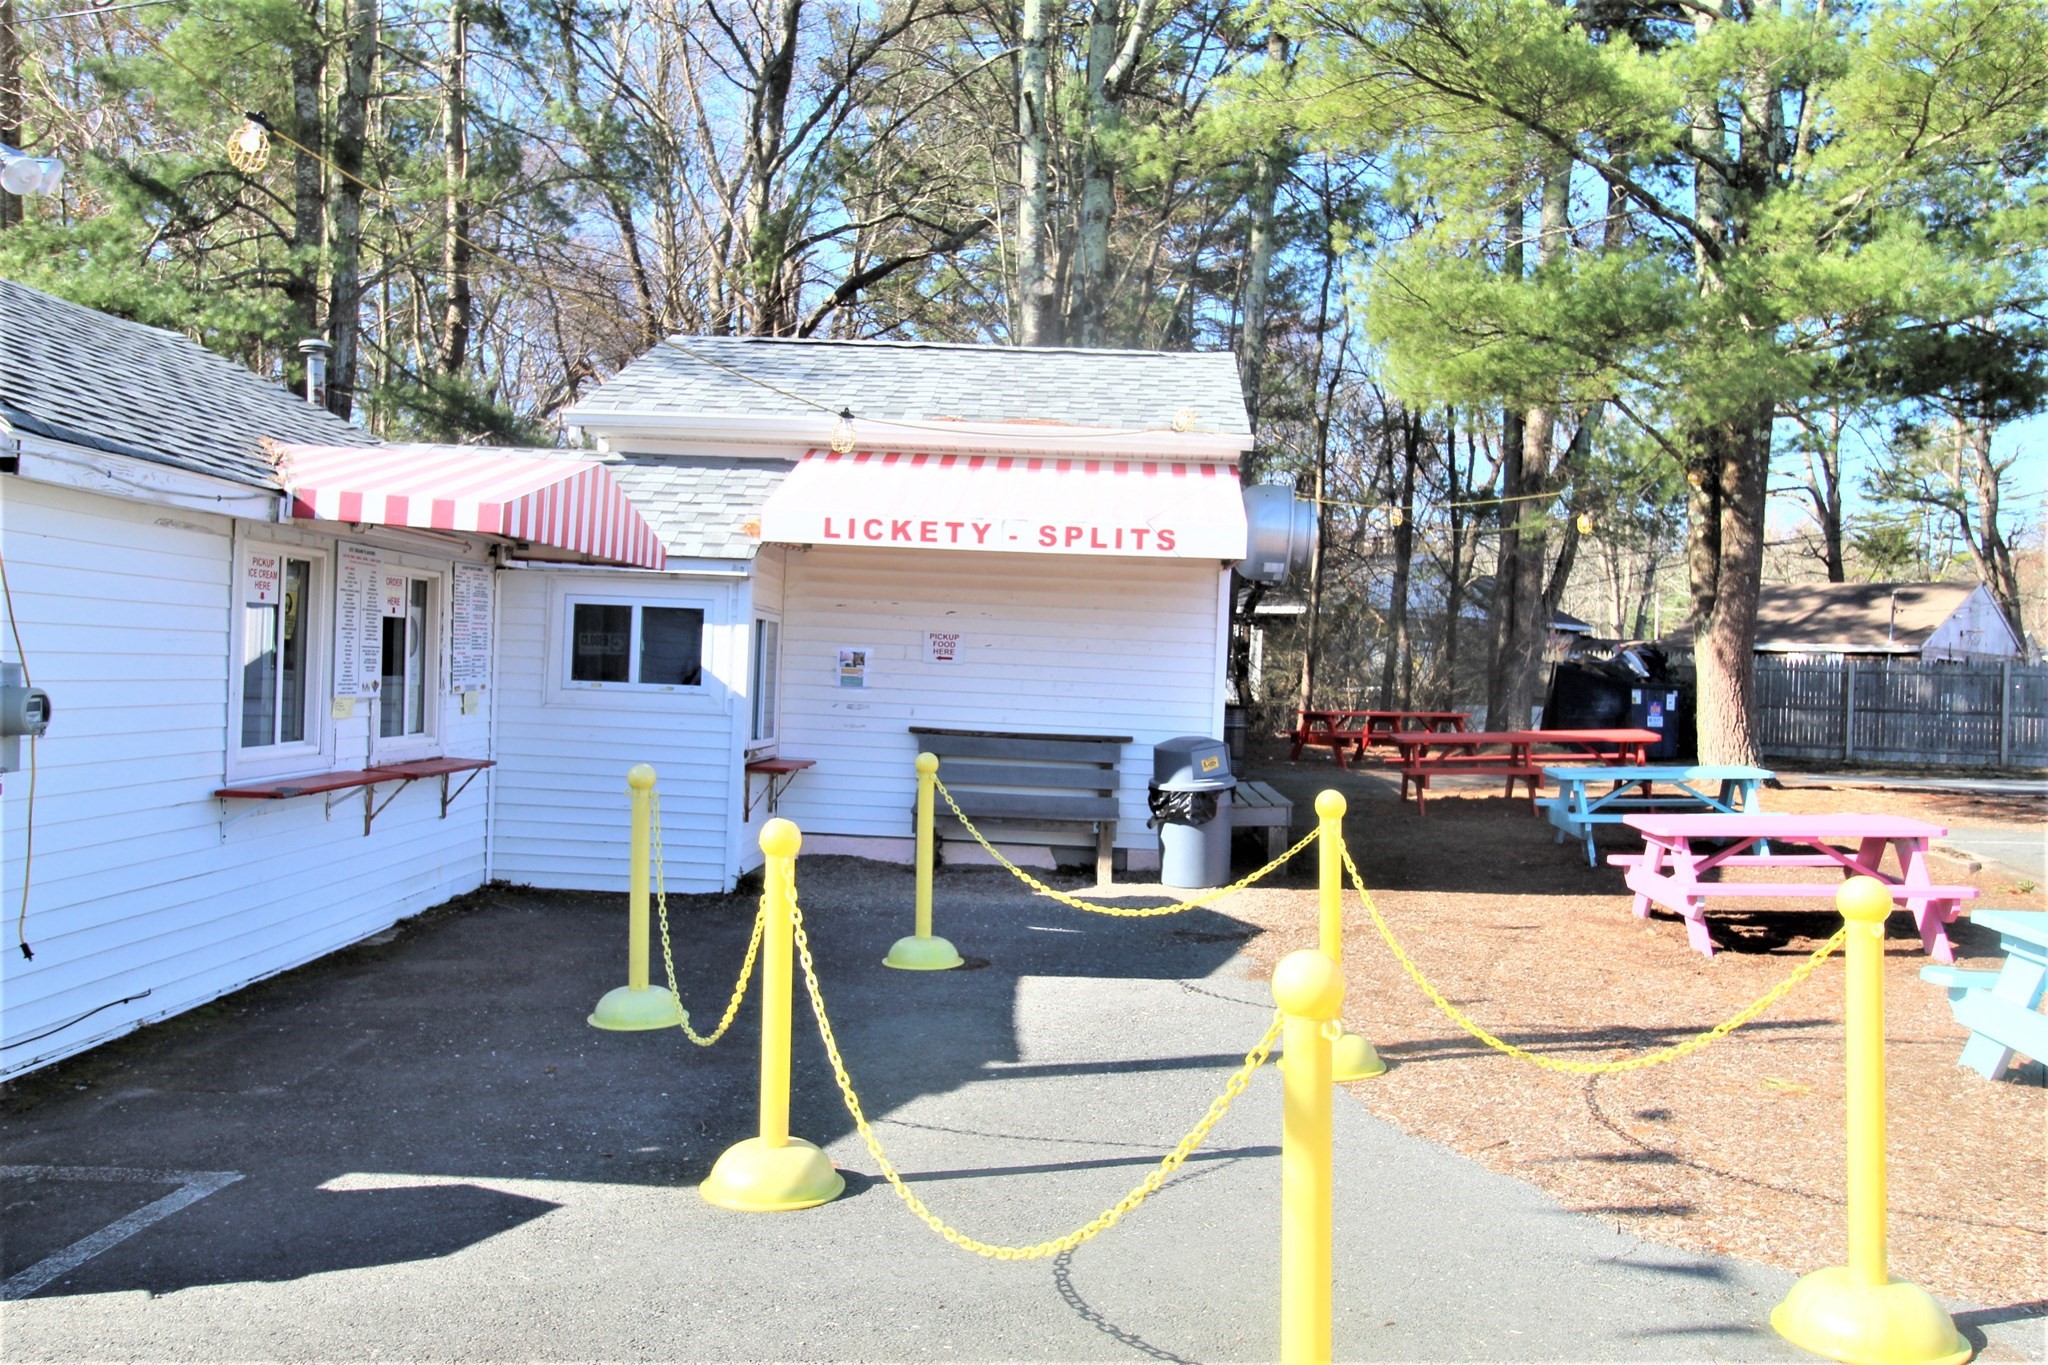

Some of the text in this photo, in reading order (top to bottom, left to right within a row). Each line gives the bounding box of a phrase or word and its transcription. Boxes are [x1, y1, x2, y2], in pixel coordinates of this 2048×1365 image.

[824, 517, 992, 544] LICKETY
[1038, 525, 1176, 551] SPLITS
[252, 556, 275, 568] PICKUP
[248, 568, 278, 580] ICE CREAM
[254, 580, 271, 591] HERE
[386, 576, 403, 587] ORDER
[387, 597, 401, 606] HERE
[929, 633, 960, 641] PICKUP
[932, 640, 956, 648] FOOD
[932, 647, 955, 656] HERE
